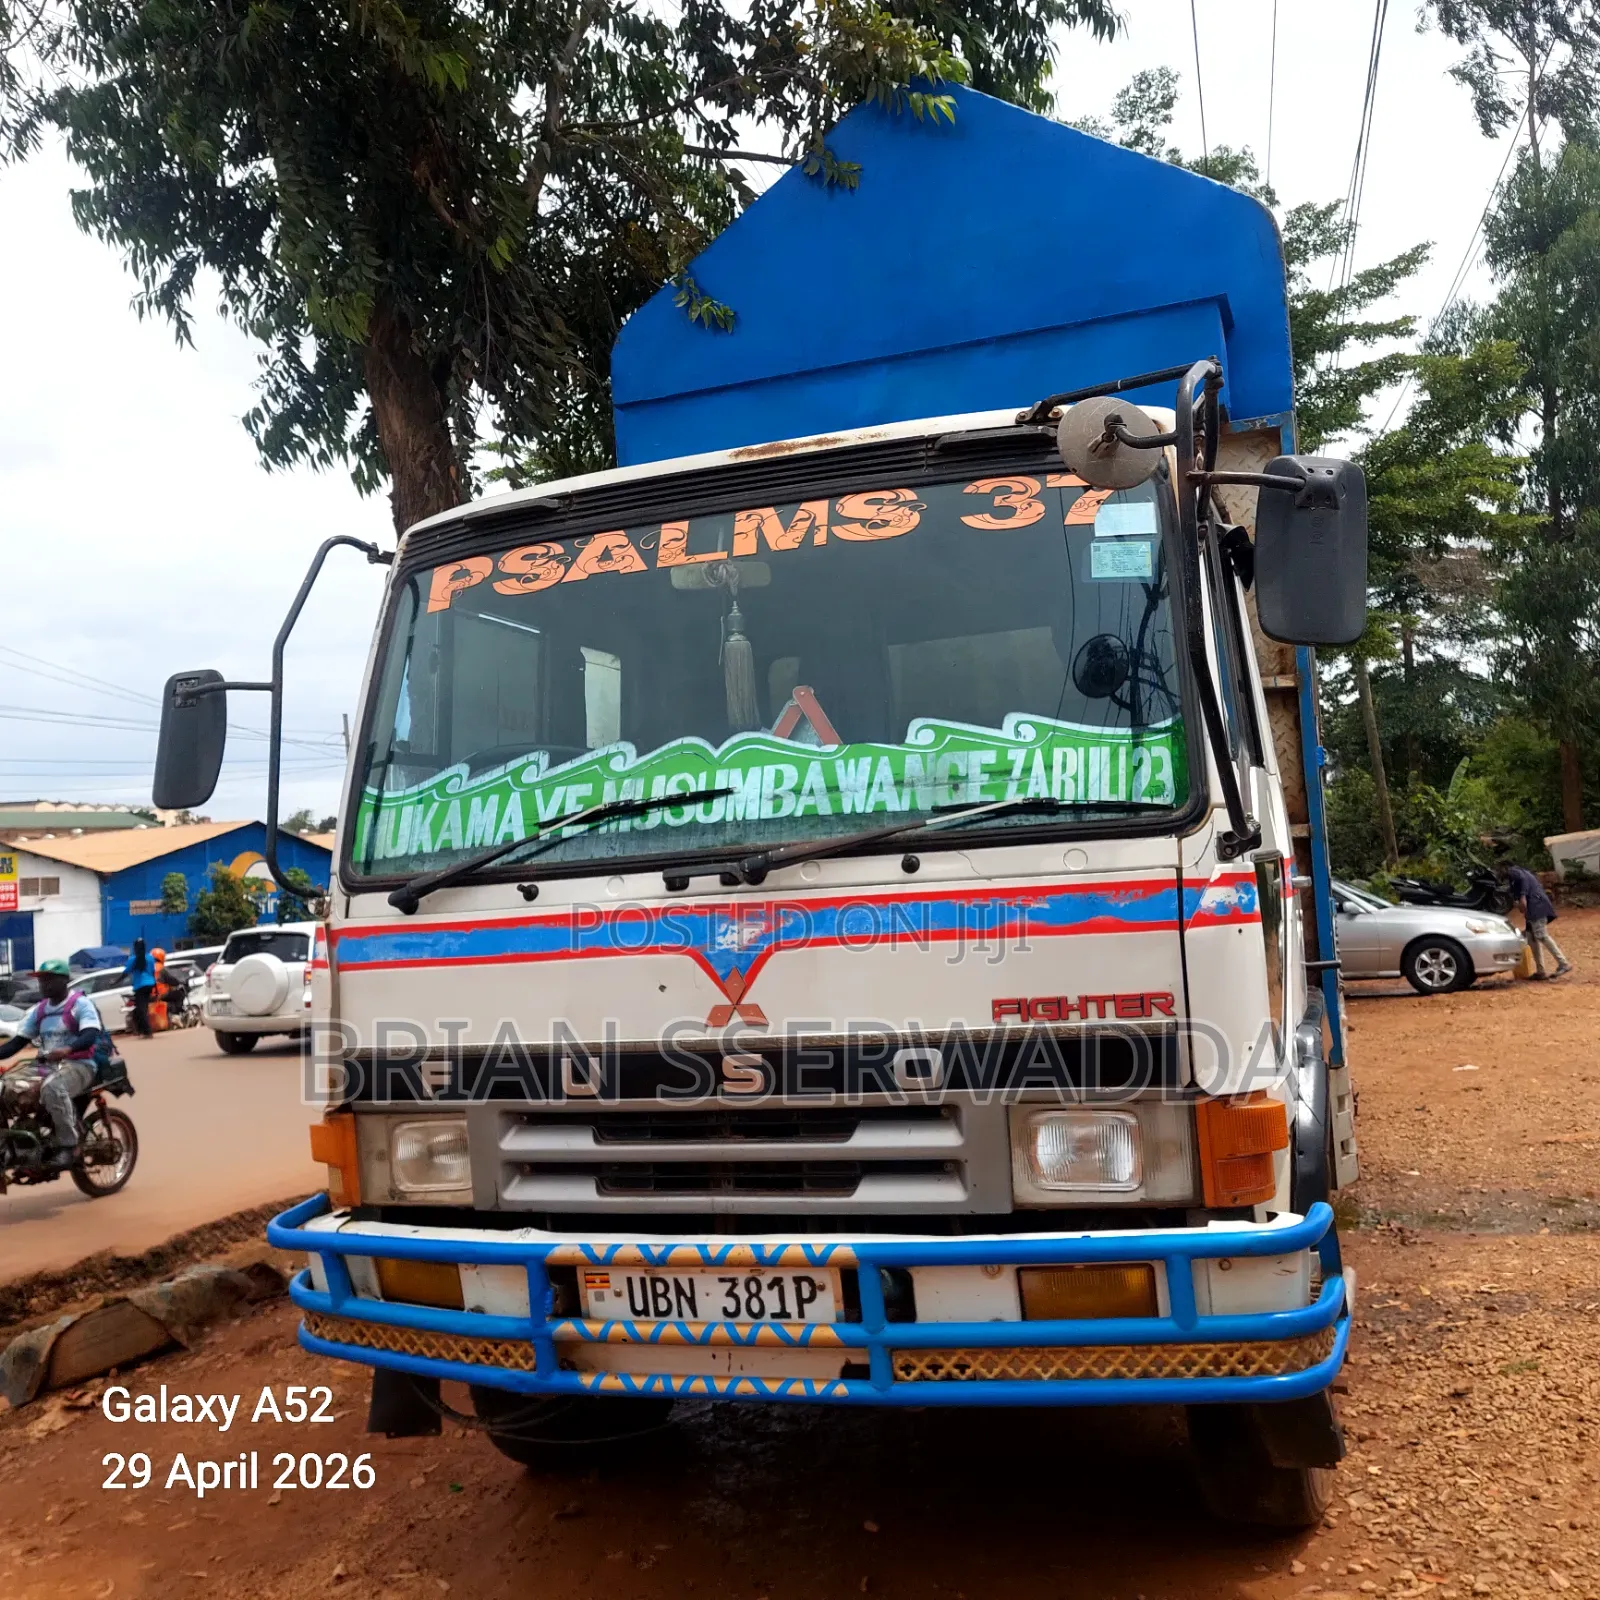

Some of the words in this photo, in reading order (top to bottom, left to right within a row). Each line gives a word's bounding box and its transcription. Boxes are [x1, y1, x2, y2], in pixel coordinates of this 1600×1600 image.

[426, 487, 928, 613] PSALMS
[960, 474, 1115, 528] 37
[1131, 746, 1176, 806] 23
[992, 992, 1176, 1022] FIGHTER
[420, 1050, 945, 1098] FUSO
[627, 1276, 699, 1318] UBN
[717, 1275, 818, 1320] 381P
